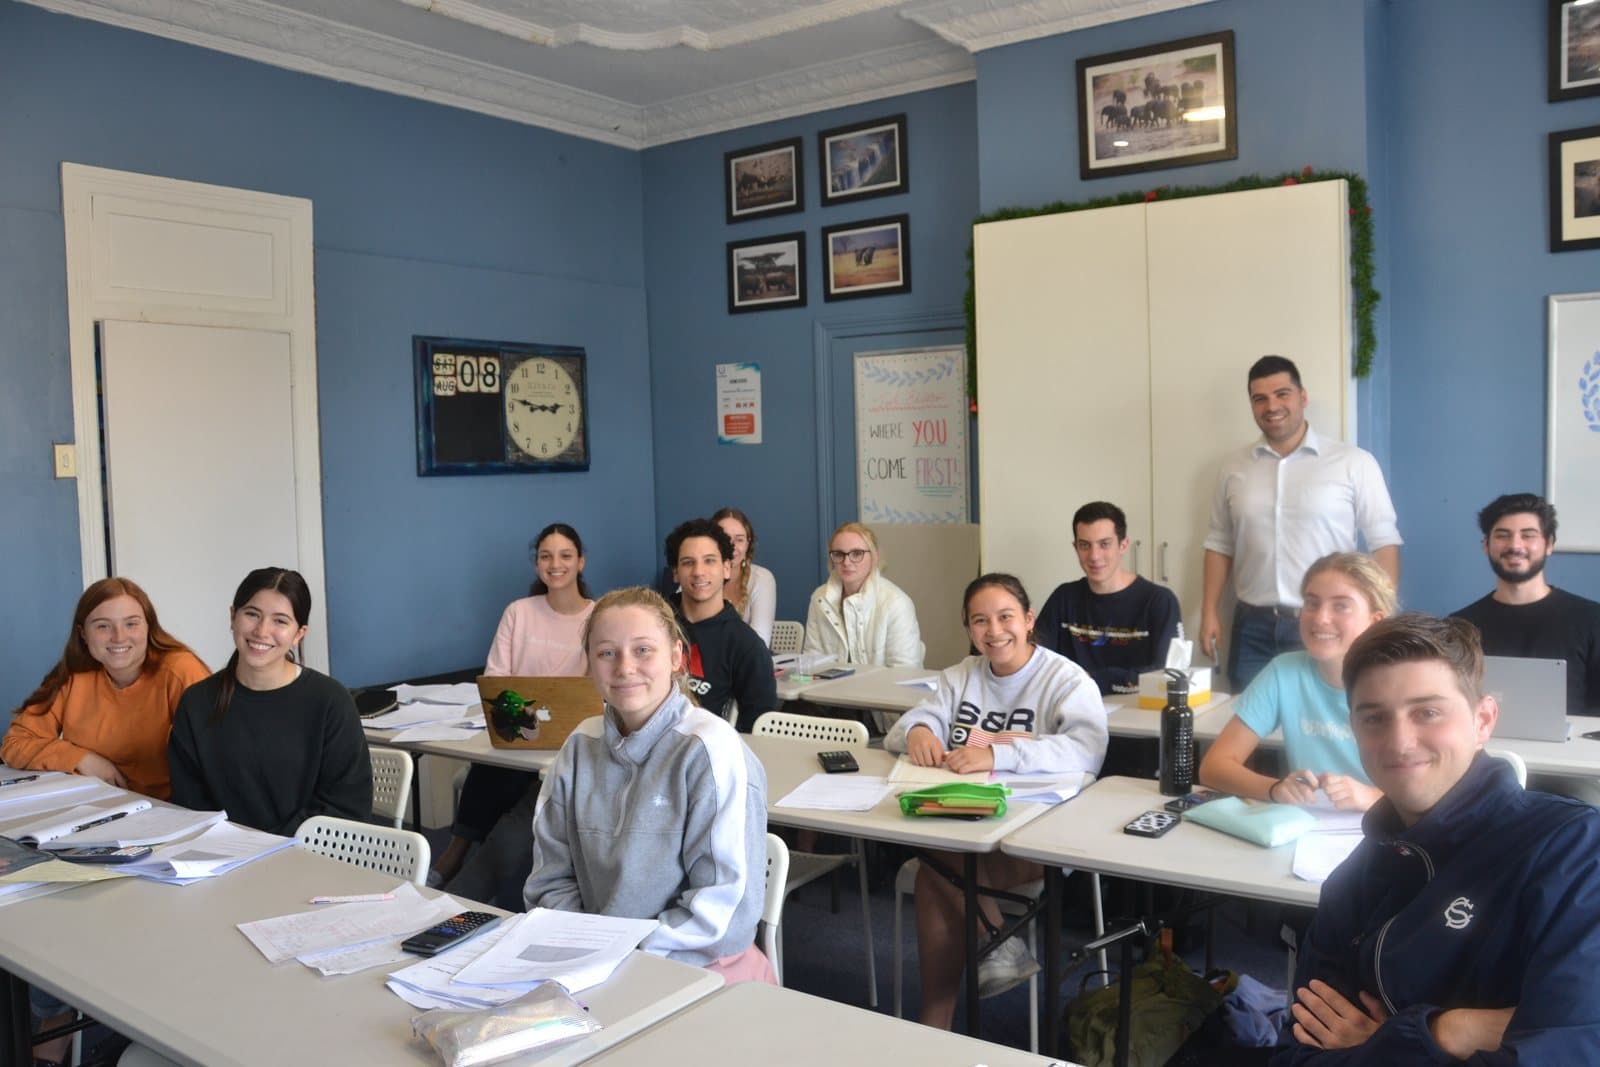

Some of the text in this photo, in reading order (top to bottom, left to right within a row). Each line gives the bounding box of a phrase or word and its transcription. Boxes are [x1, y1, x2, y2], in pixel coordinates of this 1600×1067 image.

[460, 360, 496, 388] 08
[521, 367, 529, 378] 11
[536, 363, 545, 374] 12
[554, 368, 559, 380] 1
[436, 380, 455, 392] AUG
[511, 383, 519, 393] 10
[564, 383, 571, 395] 2
[508, 401, 514, 413] 9
[568, 404, 575, 415] 3
[512, 423, 519, 433] 8
[565, 421, 571, 432] 4
[869, 418, 948, 445] WHERE YOU
[526, 437, 531, 448] 7
[541, 442, 547, 454] 6
[557, 437, 562, 448] 5
[867, 457, 907, 480] COME
[956, 701, 1035, 733] S&R
